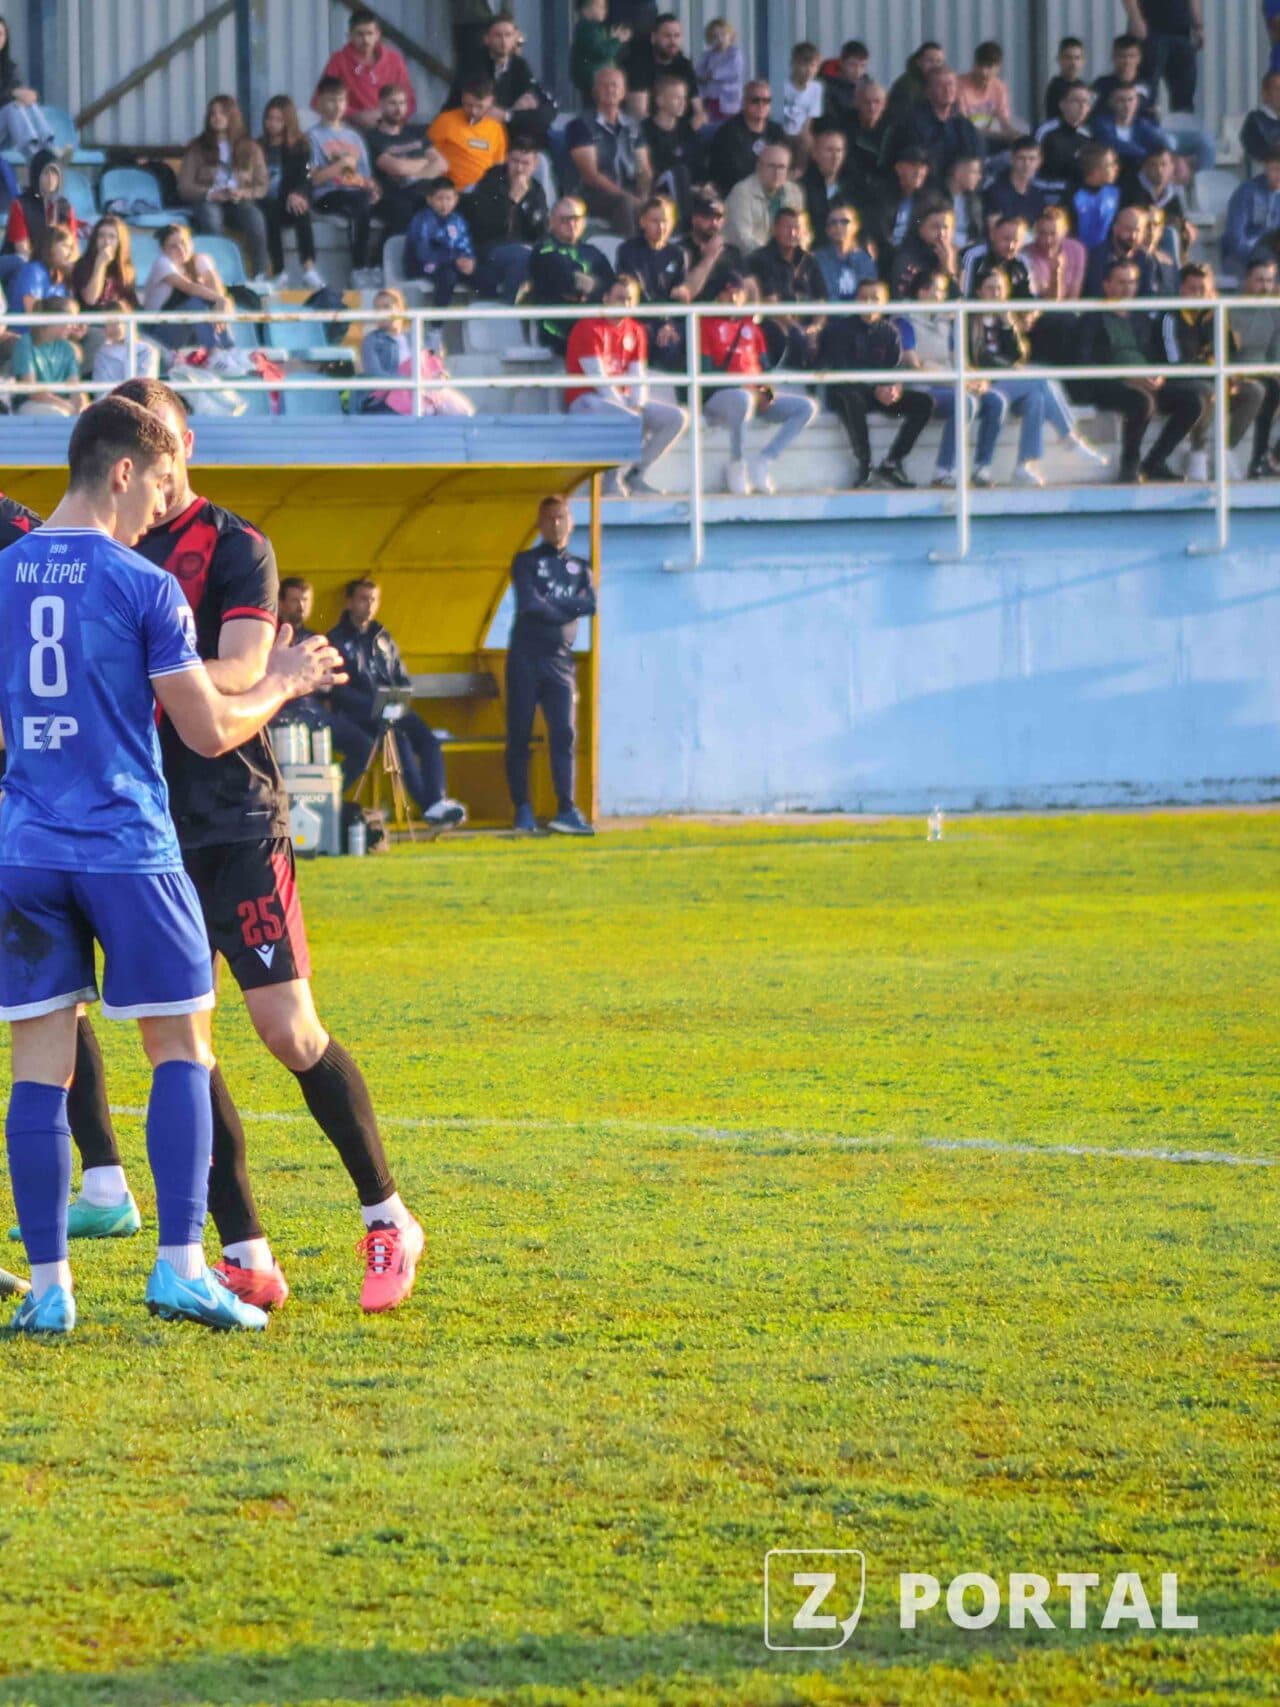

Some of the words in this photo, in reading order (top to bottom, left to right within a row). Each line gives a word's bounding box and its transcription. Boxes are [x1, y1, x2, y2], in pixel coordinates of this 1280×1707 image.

[16, 562, 40, 584] NK
[42, 558, 88, 585] ŽEPČE
[29, 595, 68, 698] 8
[237, 895, 283, 949] 25
